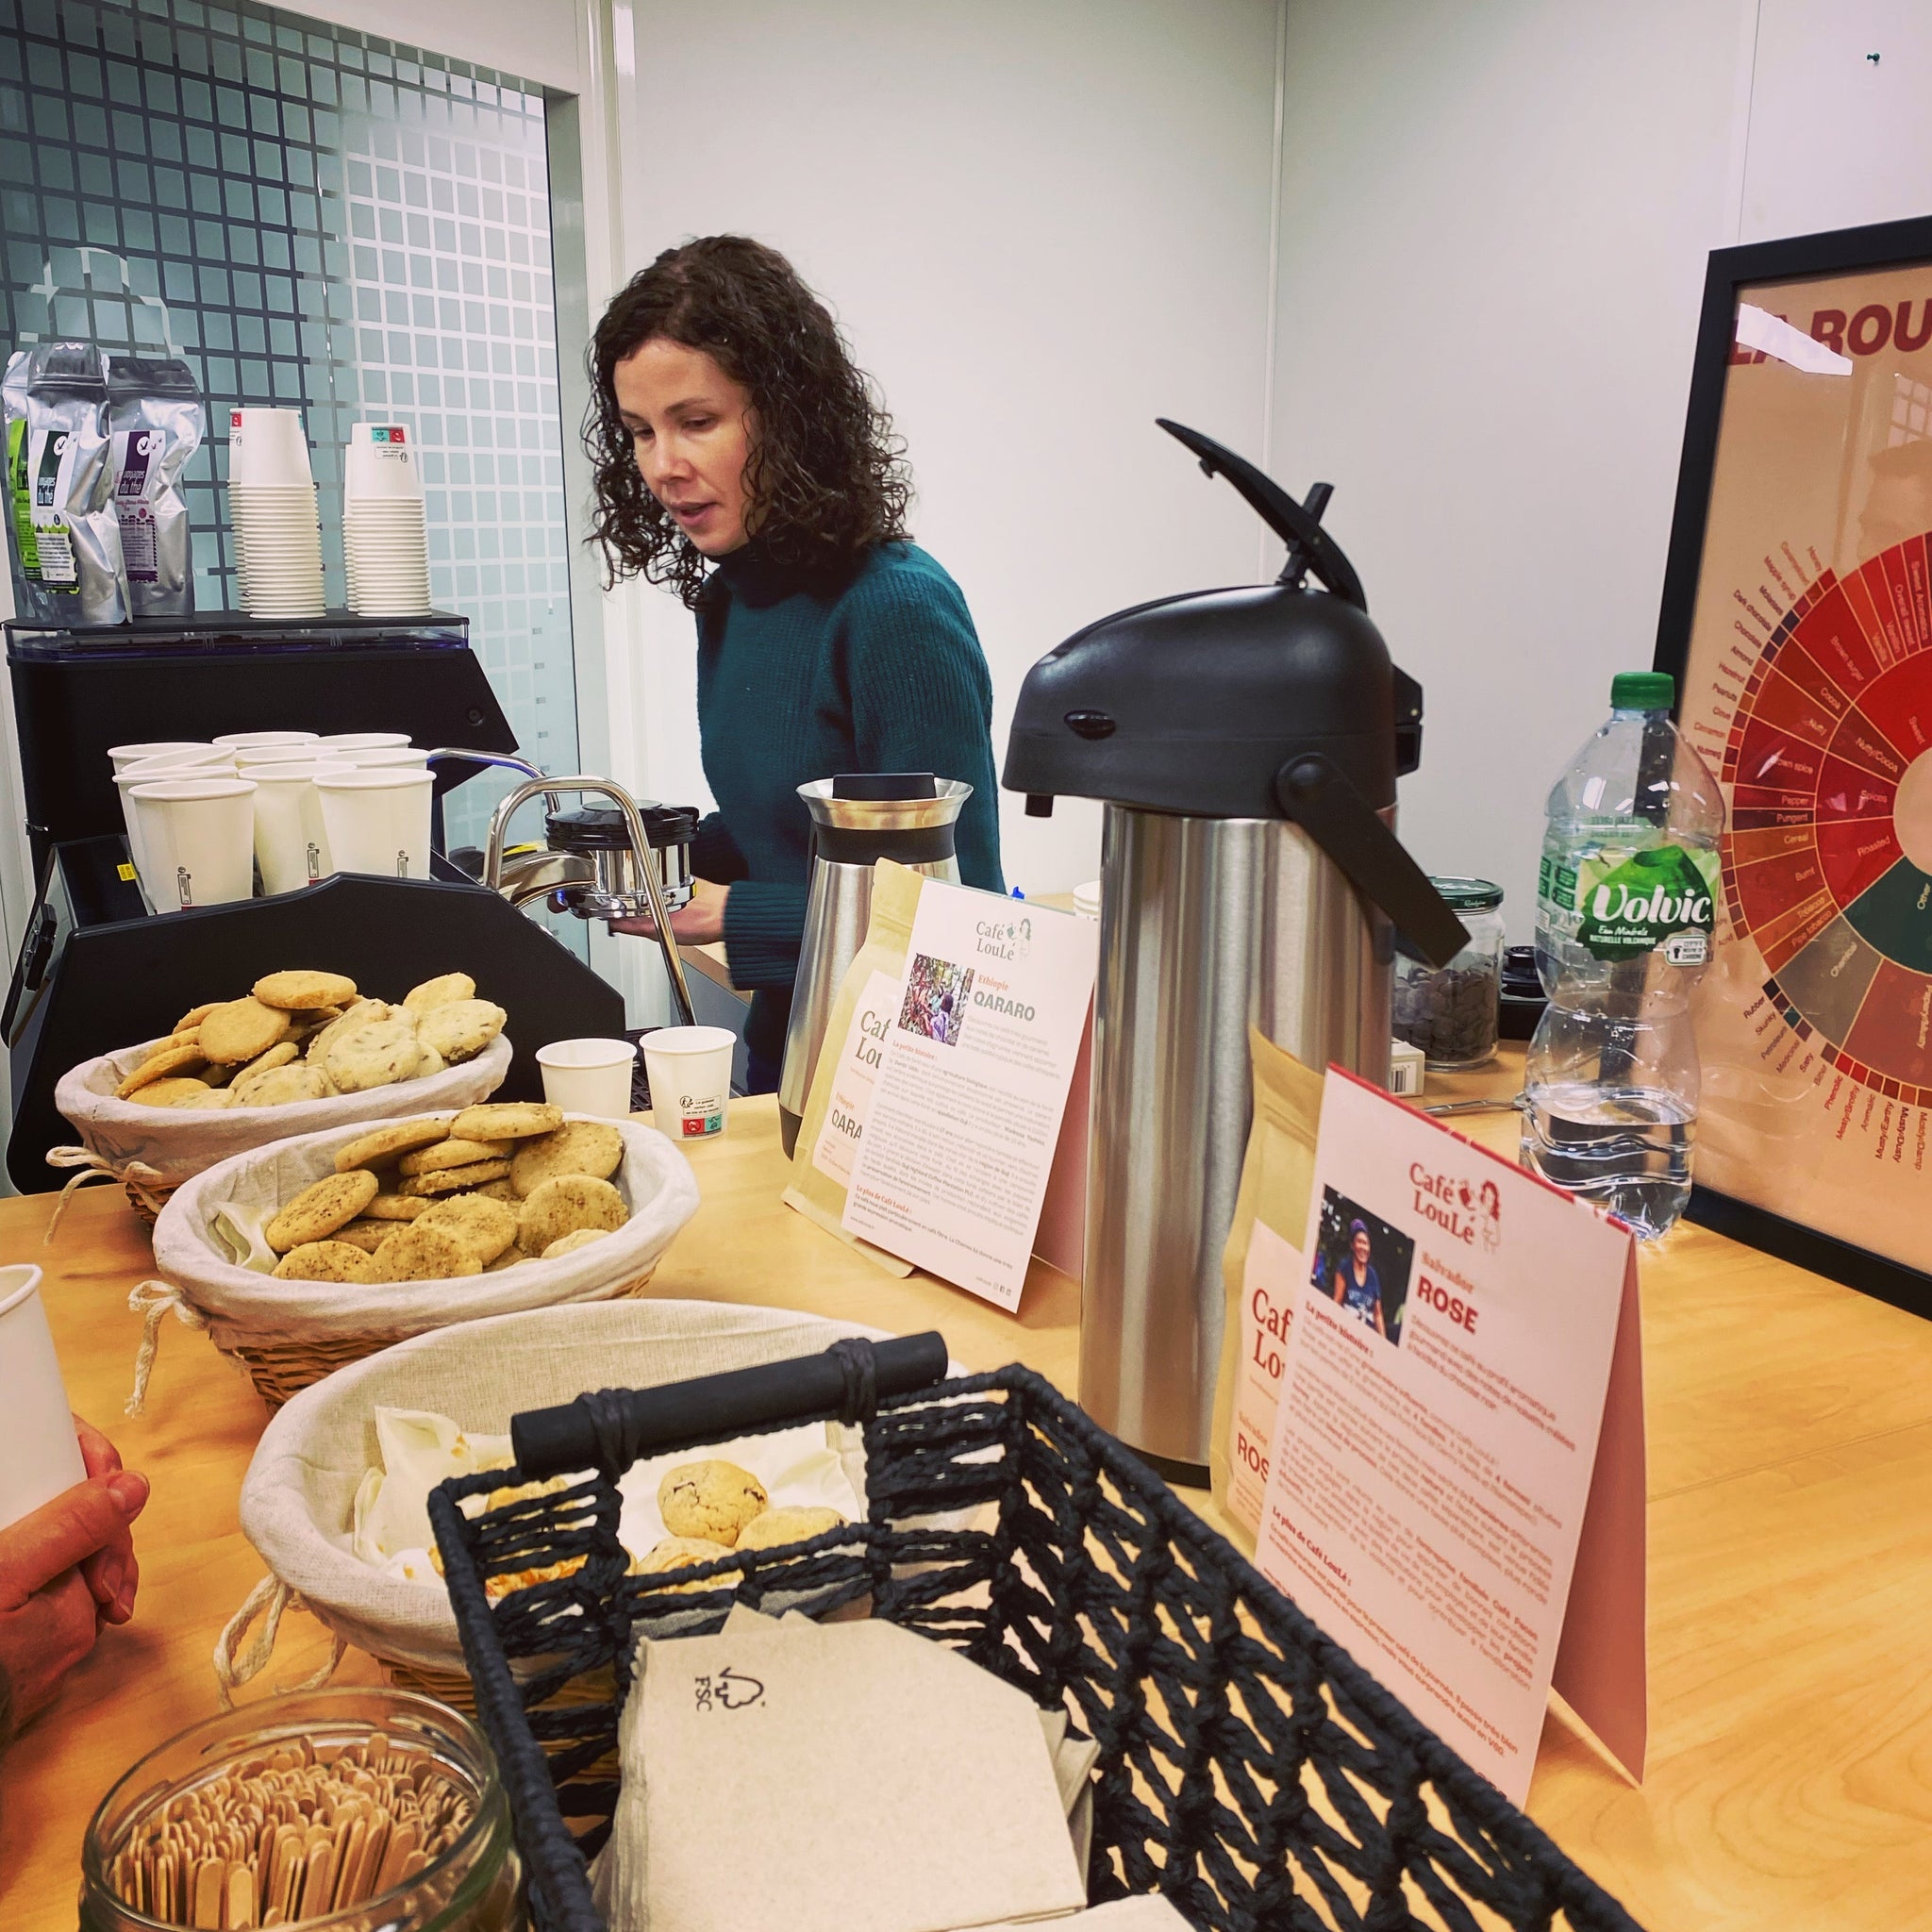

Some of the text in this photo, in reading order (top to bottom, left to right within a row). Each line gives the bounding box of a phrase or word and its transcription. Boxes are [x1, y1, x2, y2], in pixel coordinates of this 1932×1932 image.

[1592, 883, 1710, 924] Volvic
[976, 920, 1005, 941] Café
[976, 938, 1016, 961] LouLé
[977, 974, 1009, 991] Ethiopie
[974, 991, 1036, 1022] QARARO
[860, 1010, 891, 1041] Caf
[856, 1184, 862, 1192] Le
[874, 1191, 880, 1201] de
[880, 1195, 892, 1206] Café
[1409, 1162, 1457, 1206] Café
[1413, 1190, 1476, 1246] LouLé
[1252, 1288, 1293, 1345] Caf
[1417, 1274, 1479, 1335] ROSE
[1272, 1504, 1281, 1522] Le
[1281, 1512, 1296, 1536] plus
[1296, 1527, 1306, 1544] de
[1306, 1536, 1323, 1560] Café
[1323, 1552, 1347, 1584] LouLé
[695, 1676, 712, 1711] FSC
